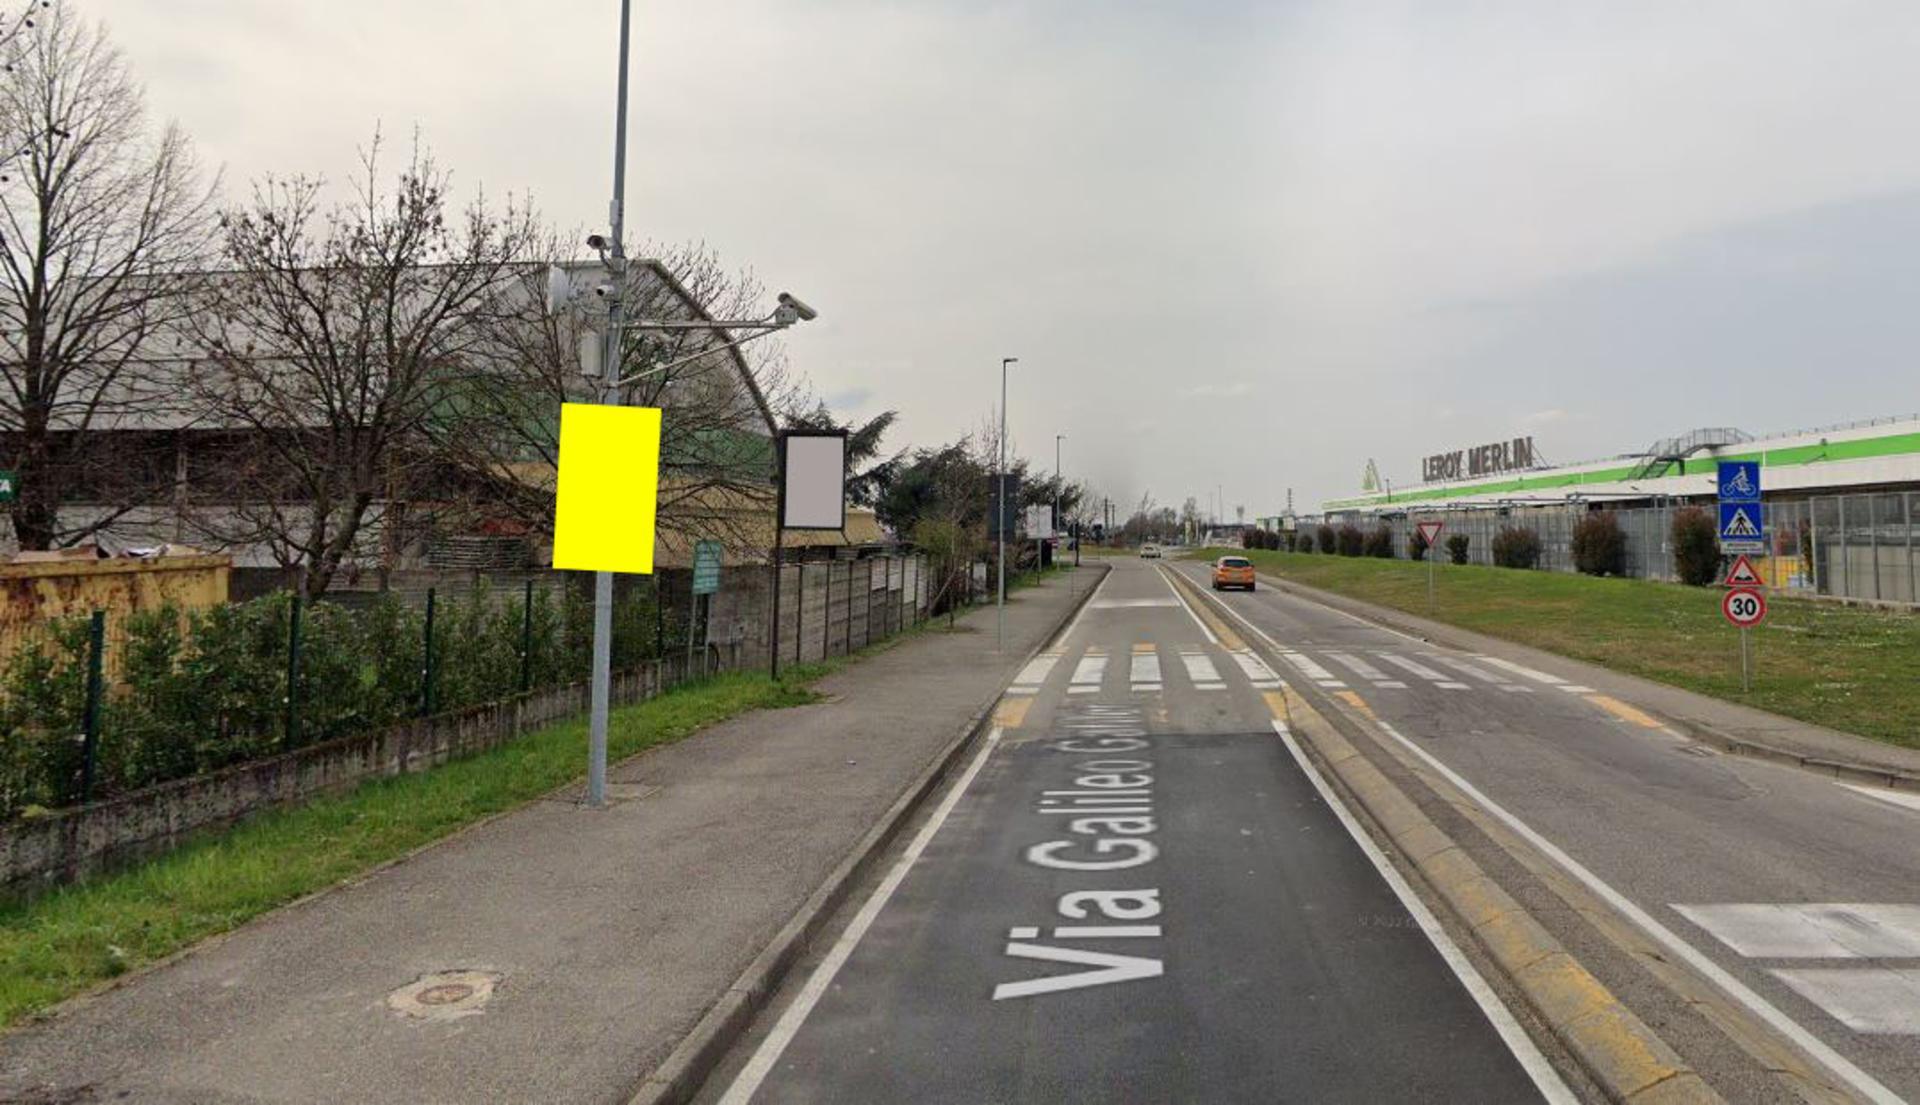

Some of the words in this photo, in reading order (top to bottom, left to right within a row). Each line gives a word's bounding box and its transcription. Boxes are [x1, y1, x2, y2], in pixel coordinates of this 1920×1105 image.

[1422, 450, 1463, 482] LEROY
[1469, 436, 1532, 476] MERLIN
[1732, 598, 1757, 616] 30
[1027, 759, 1159, 870] Galileo
[991, 887, 1164, 1001] Via
